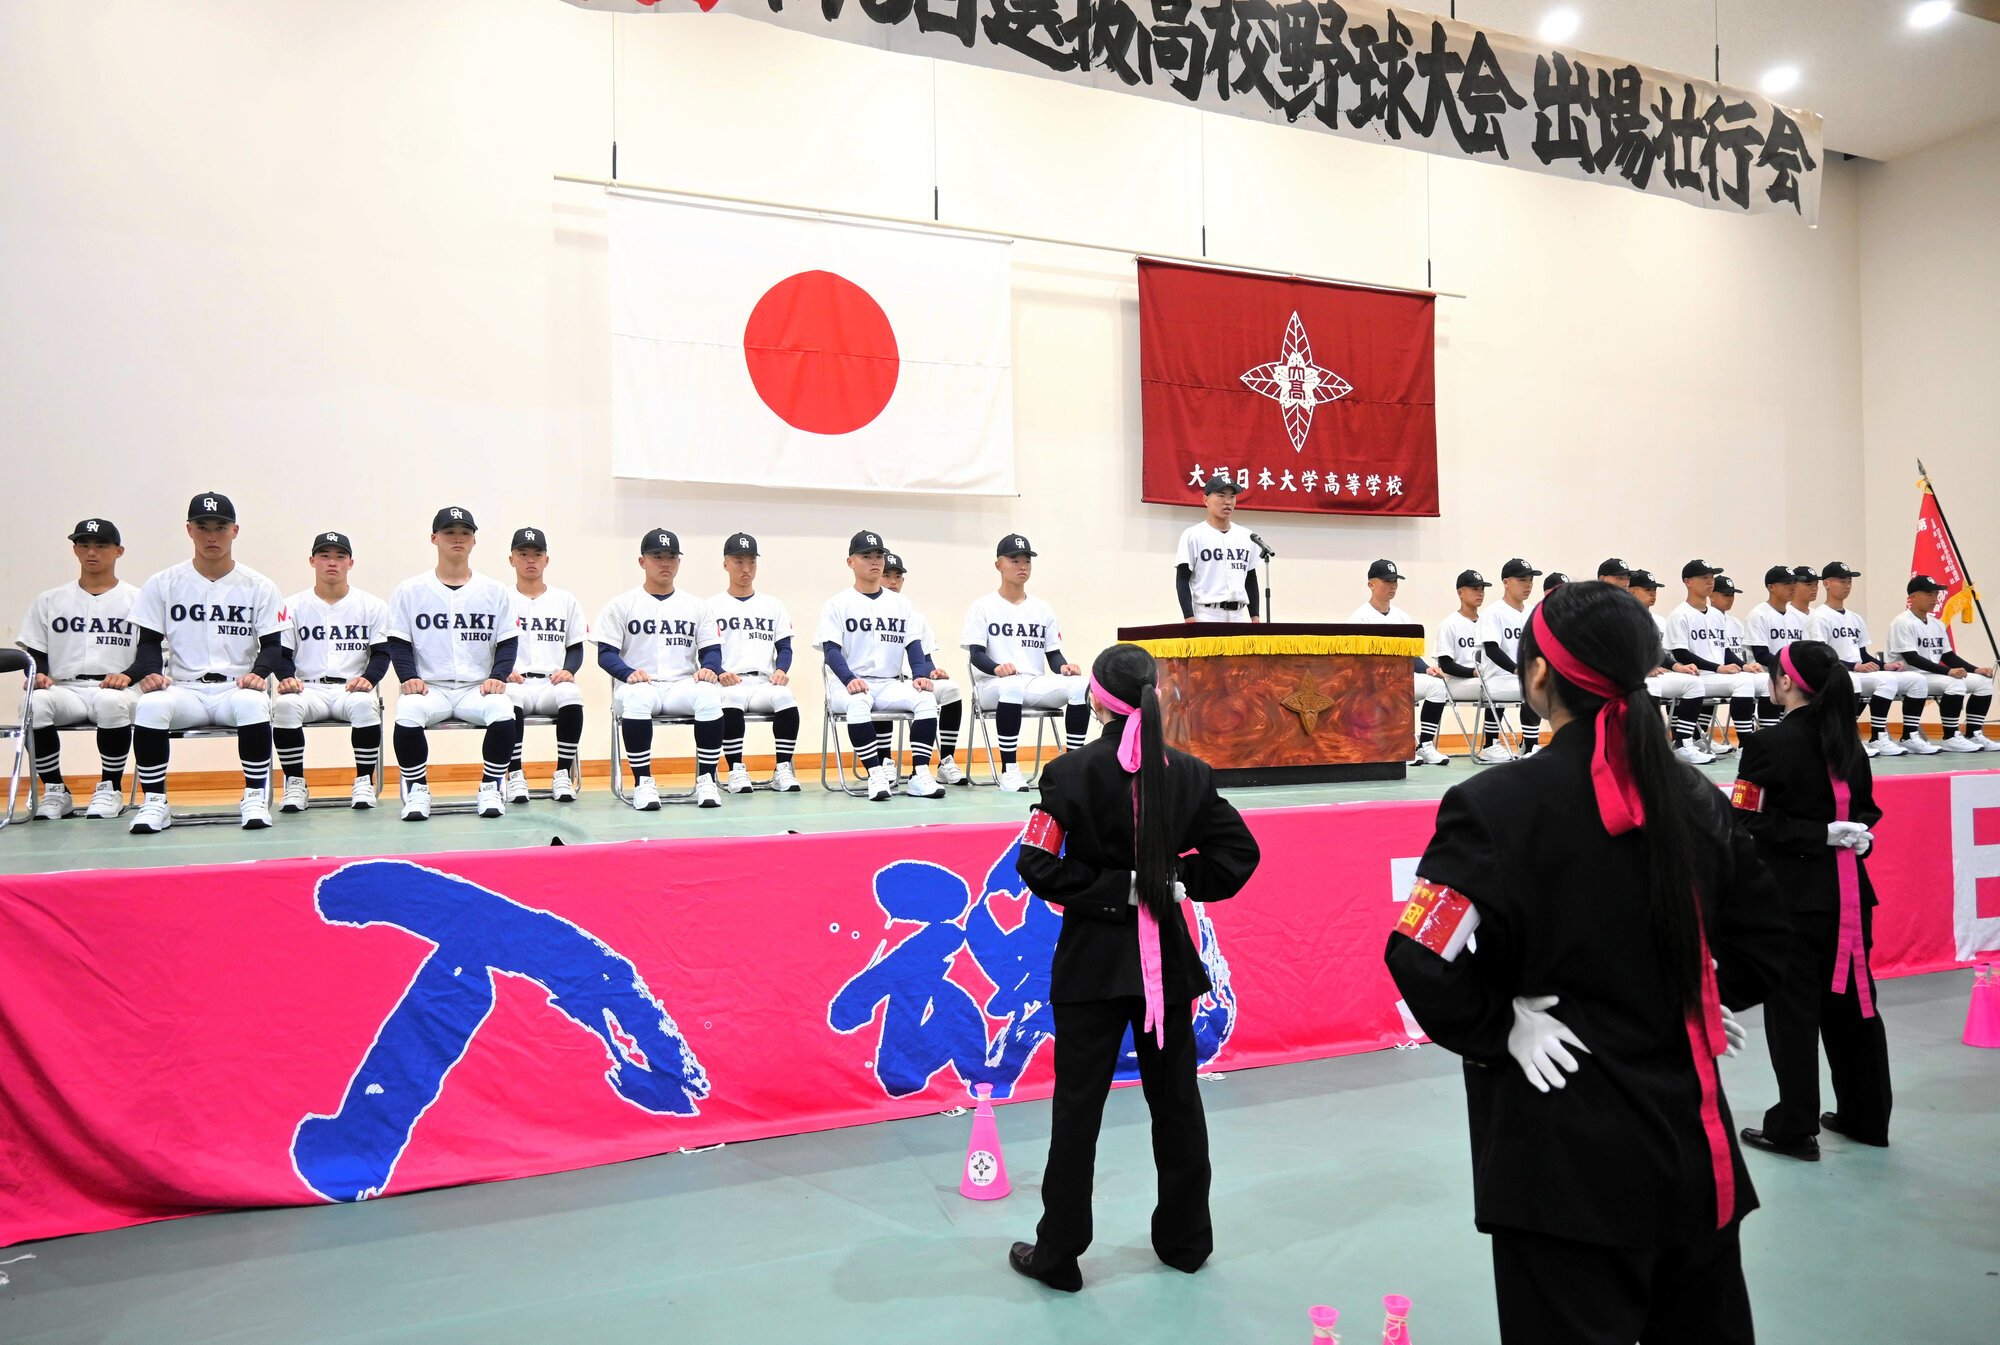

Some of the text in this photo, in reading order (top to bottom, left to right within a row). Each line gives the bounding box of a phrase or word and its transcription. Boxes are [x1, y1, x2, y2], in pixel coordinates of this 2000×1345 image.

[1532, 50, 1817, 215] 出場壮行会
[51, 616, 133, 635] OGAKI
[415, 612, 496, 631] OGAKI
[518, 617, 566, 633] GAKI
[627, 619, 696, 637] OGAKI
[716, 617, 774, 632] OGAKI
[845, 617, 906, 633] OGAKI
[299, 624, 369, 641] OGAKI
[988, 622, 1047, 639] OGAKI
[96, 635, 131, 648] NIHON
[335, 642, 369, 652] NIHON
[1401, 902, 1425, 929] 団
